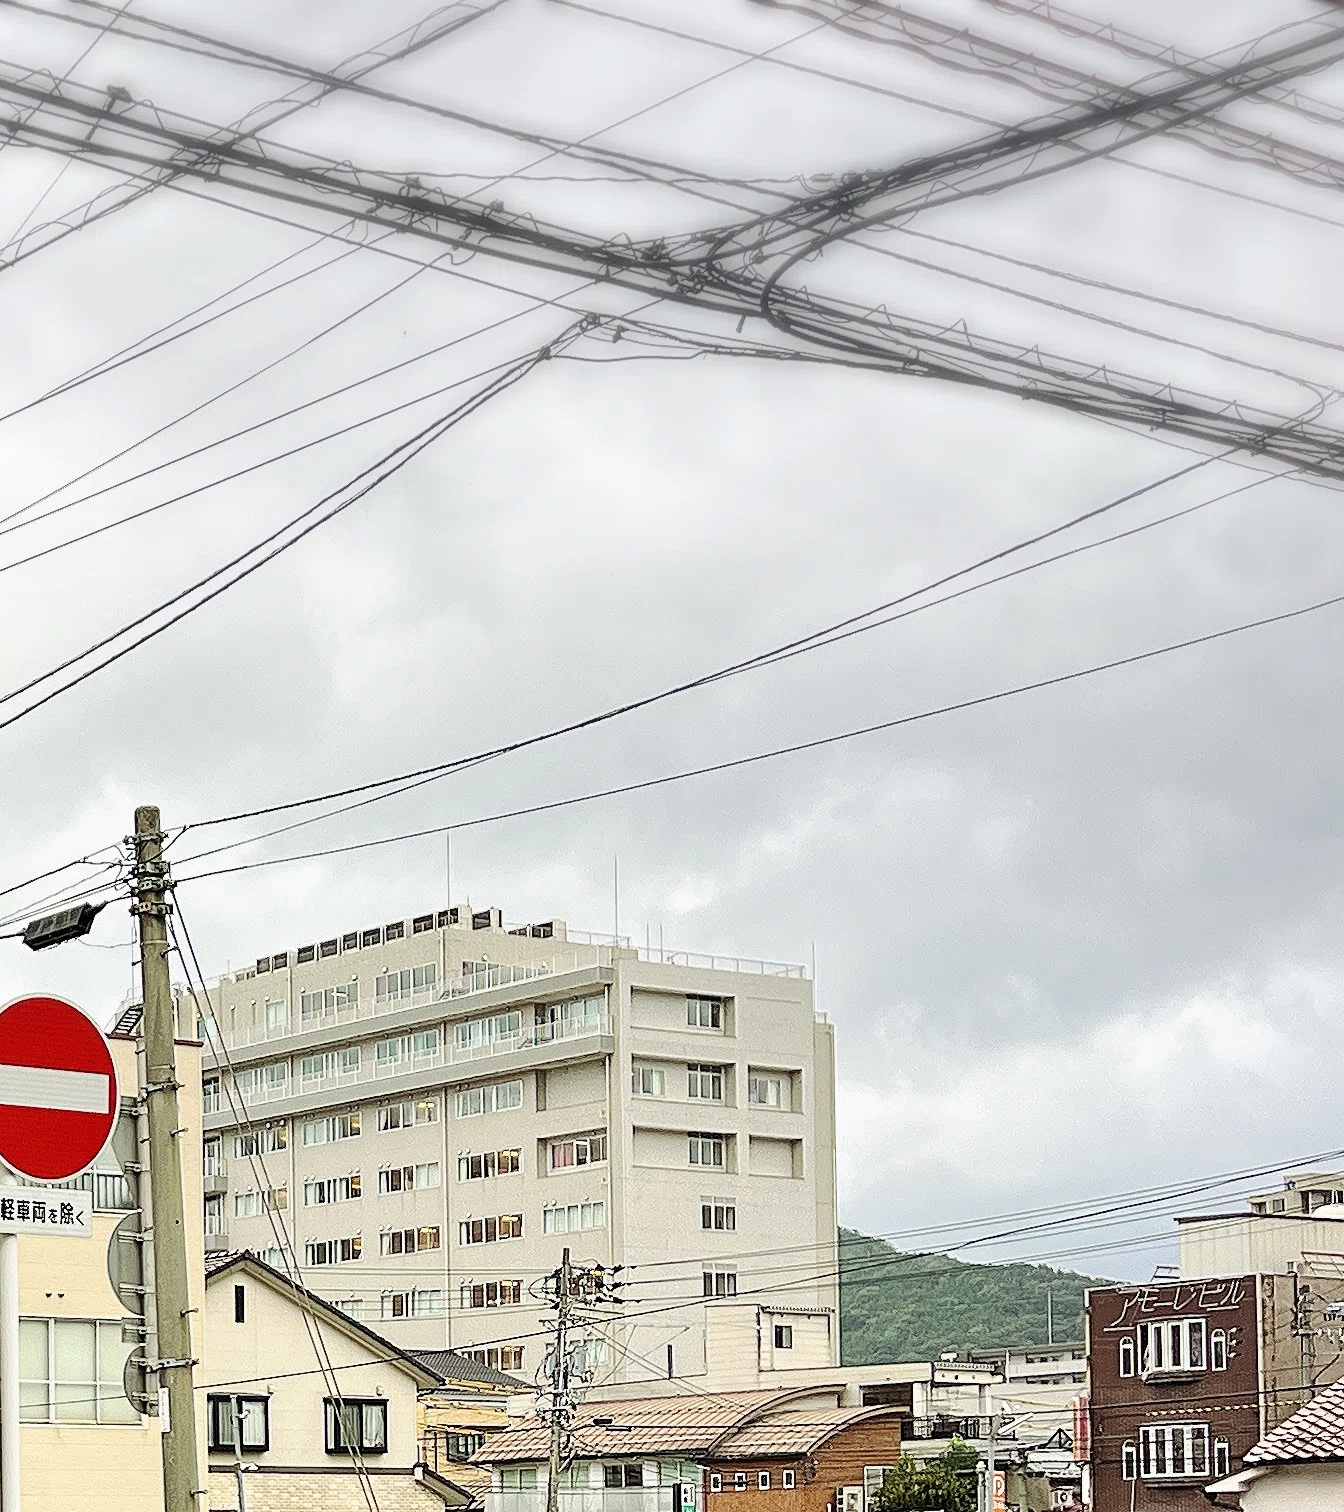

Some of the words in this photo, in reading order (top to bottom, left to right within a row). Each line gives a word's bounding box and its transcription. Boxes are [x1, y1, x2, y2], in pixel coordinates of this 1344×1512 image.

[0, 1197, 85, 1226] 軽車両を除く
